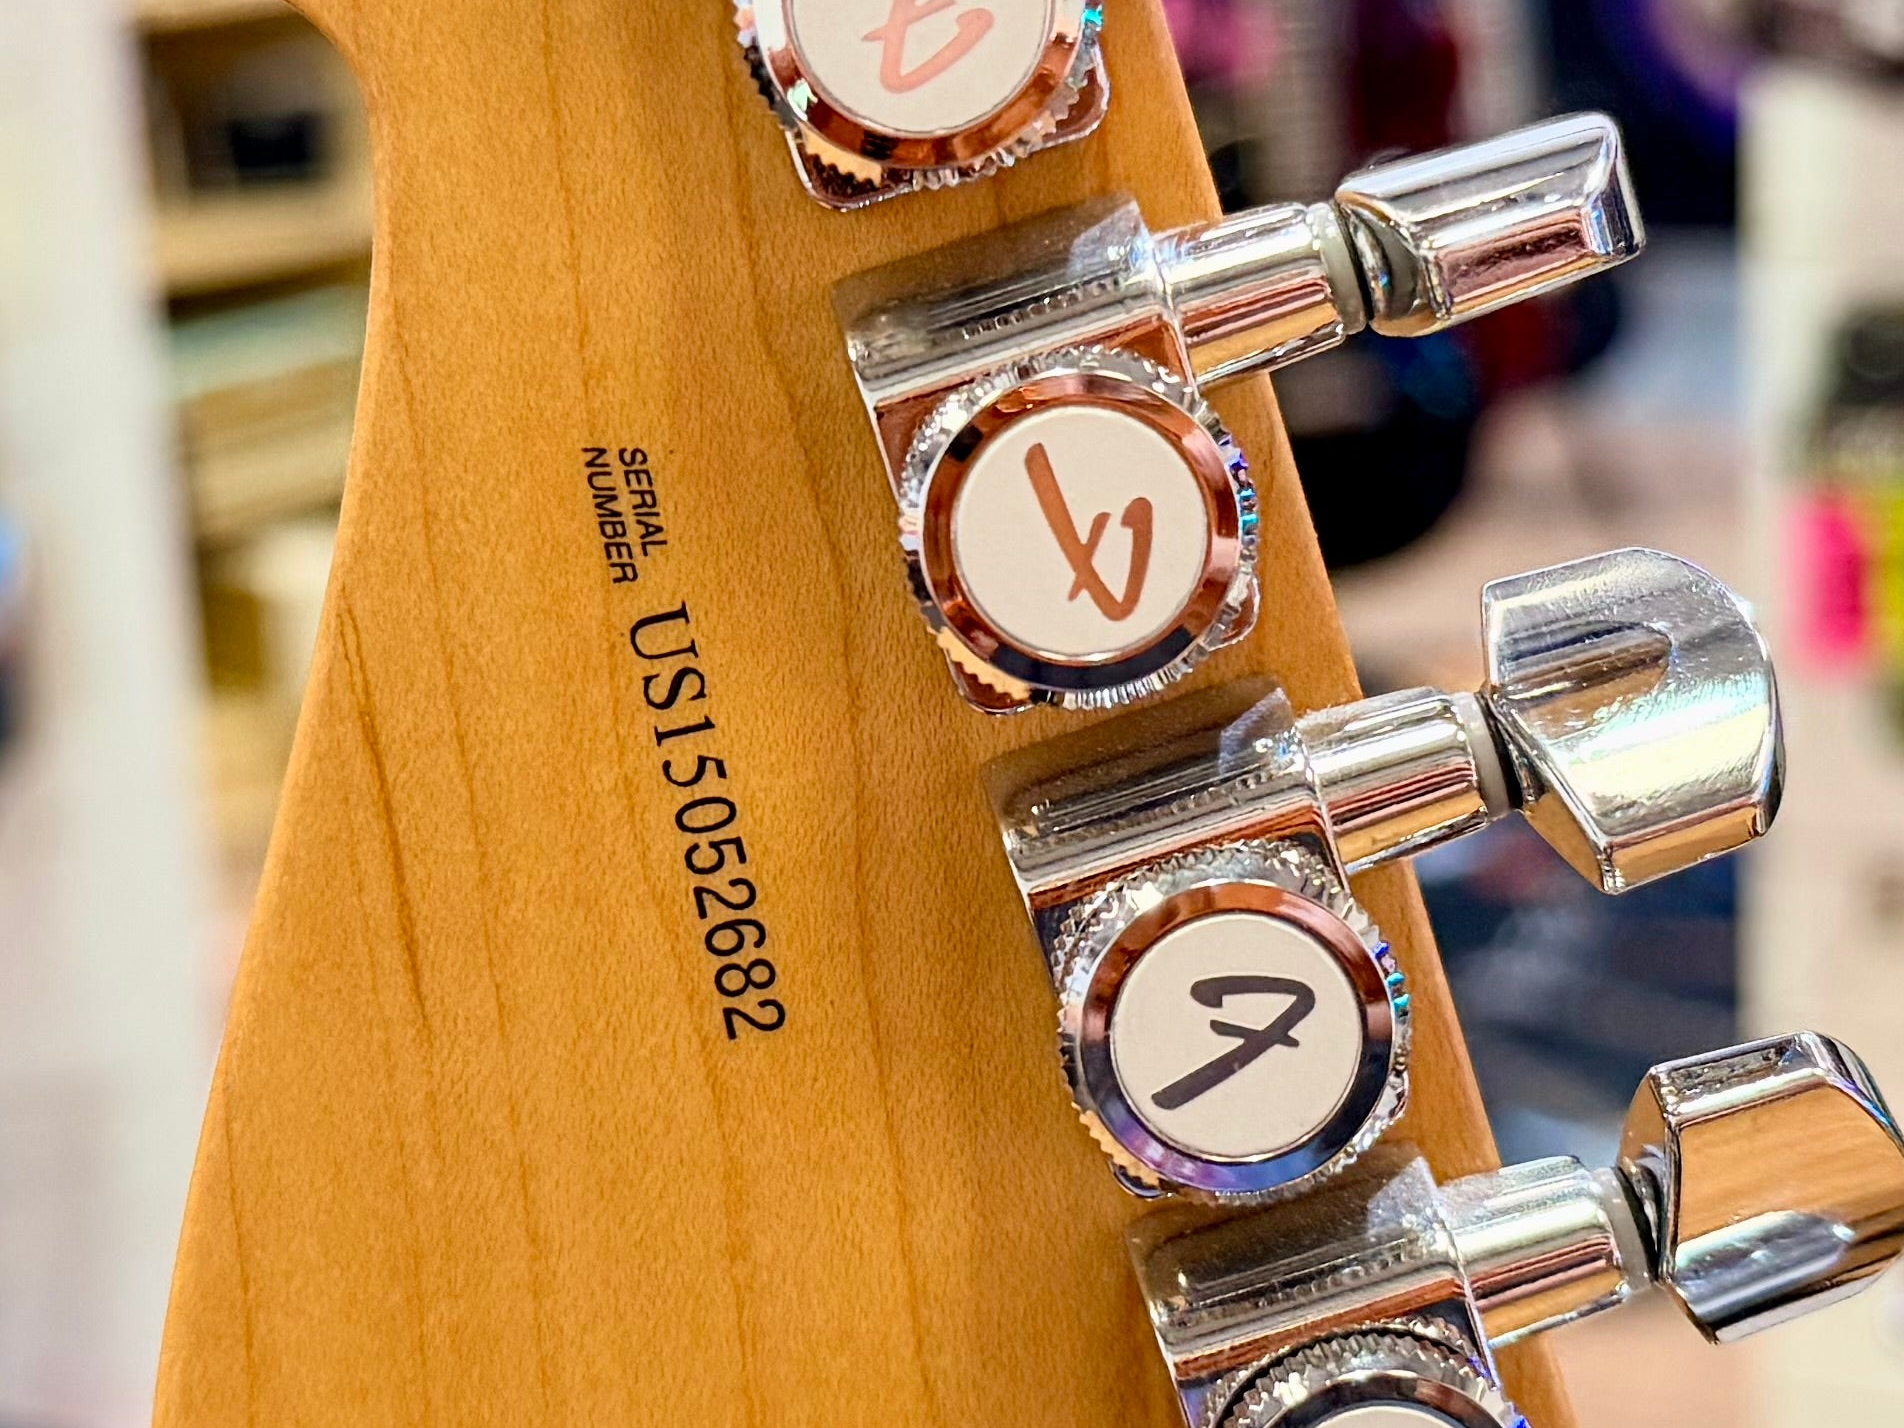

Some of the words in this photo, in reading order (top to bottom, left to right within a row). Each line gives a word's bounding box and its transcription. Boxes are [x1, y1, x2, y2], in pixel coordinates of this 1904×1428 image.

[580, 446, 640, 585] NUMBER
[617, 446, 669, 559] SERIAL
[628, 599, 788, 1042] US15052682
